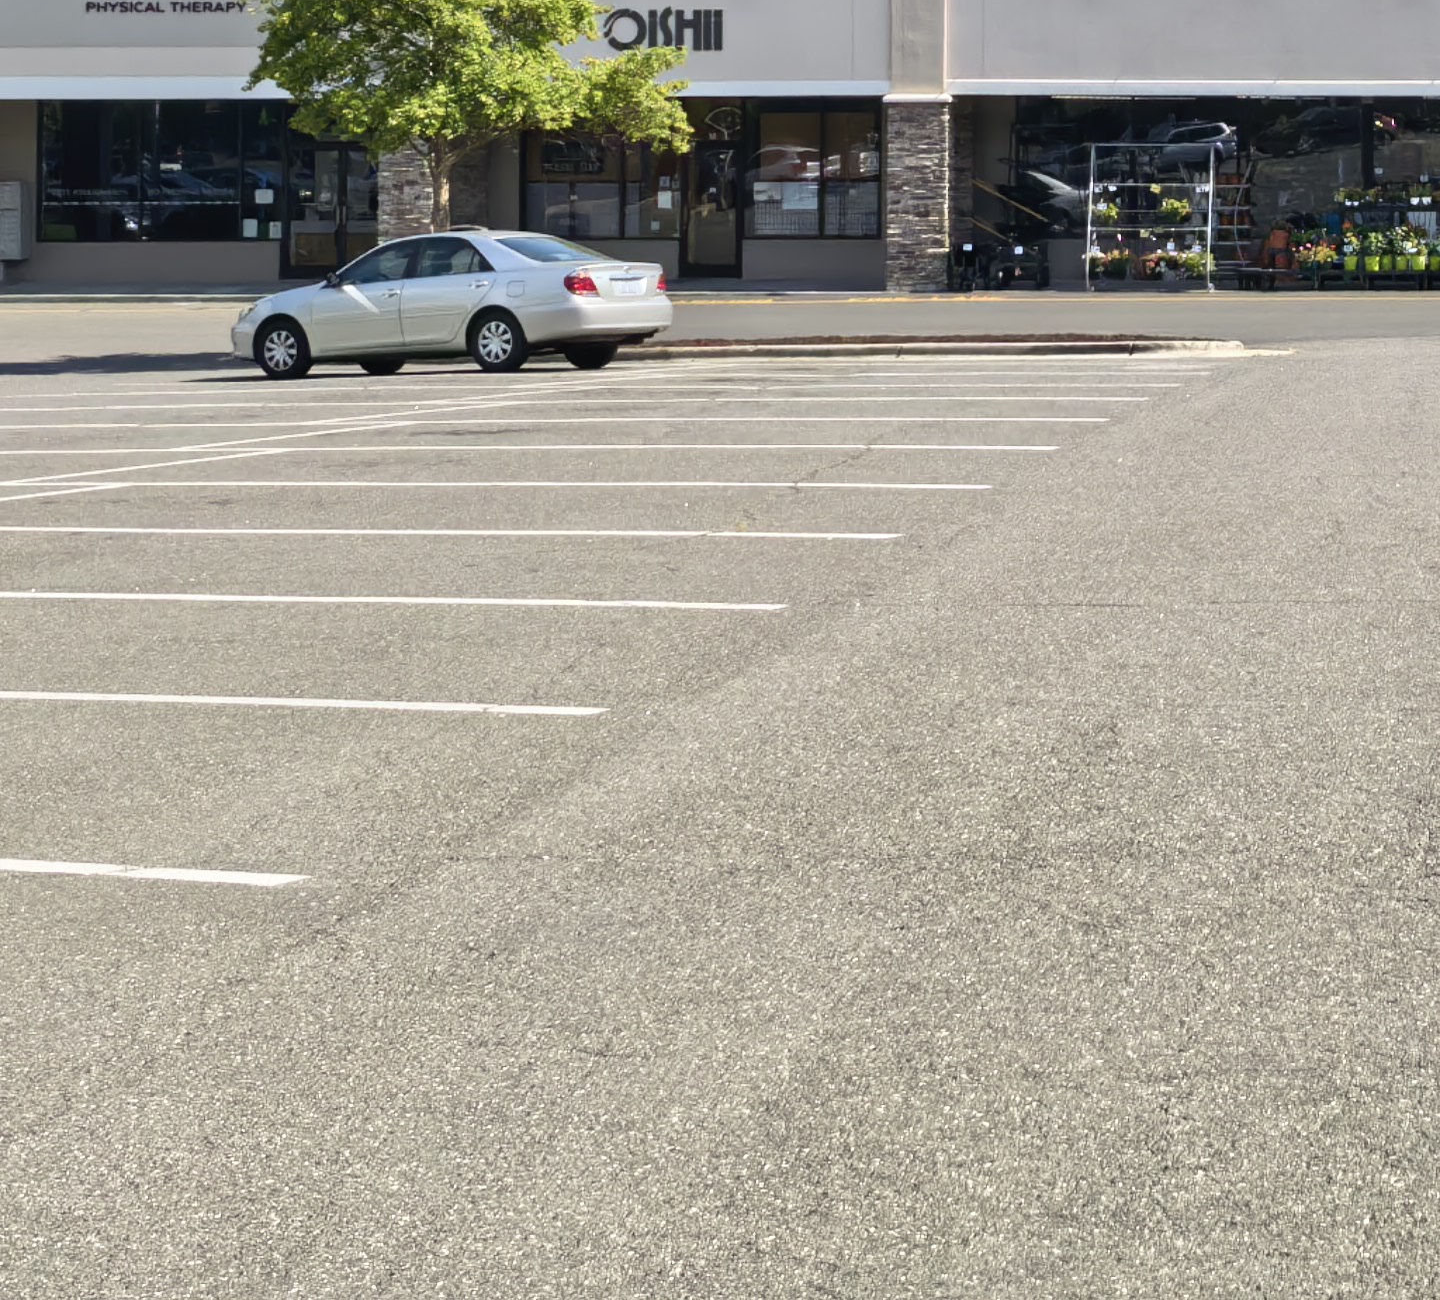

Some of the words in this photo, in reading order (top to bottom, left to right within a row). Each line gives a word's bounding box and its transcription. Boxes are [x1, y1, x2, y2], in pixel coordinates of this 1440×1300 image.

[85, 1, 165, 13] PHYSICAL
[170, 1, 247, 13] THERAPY
[603, 6, 723, 51] OISHII
